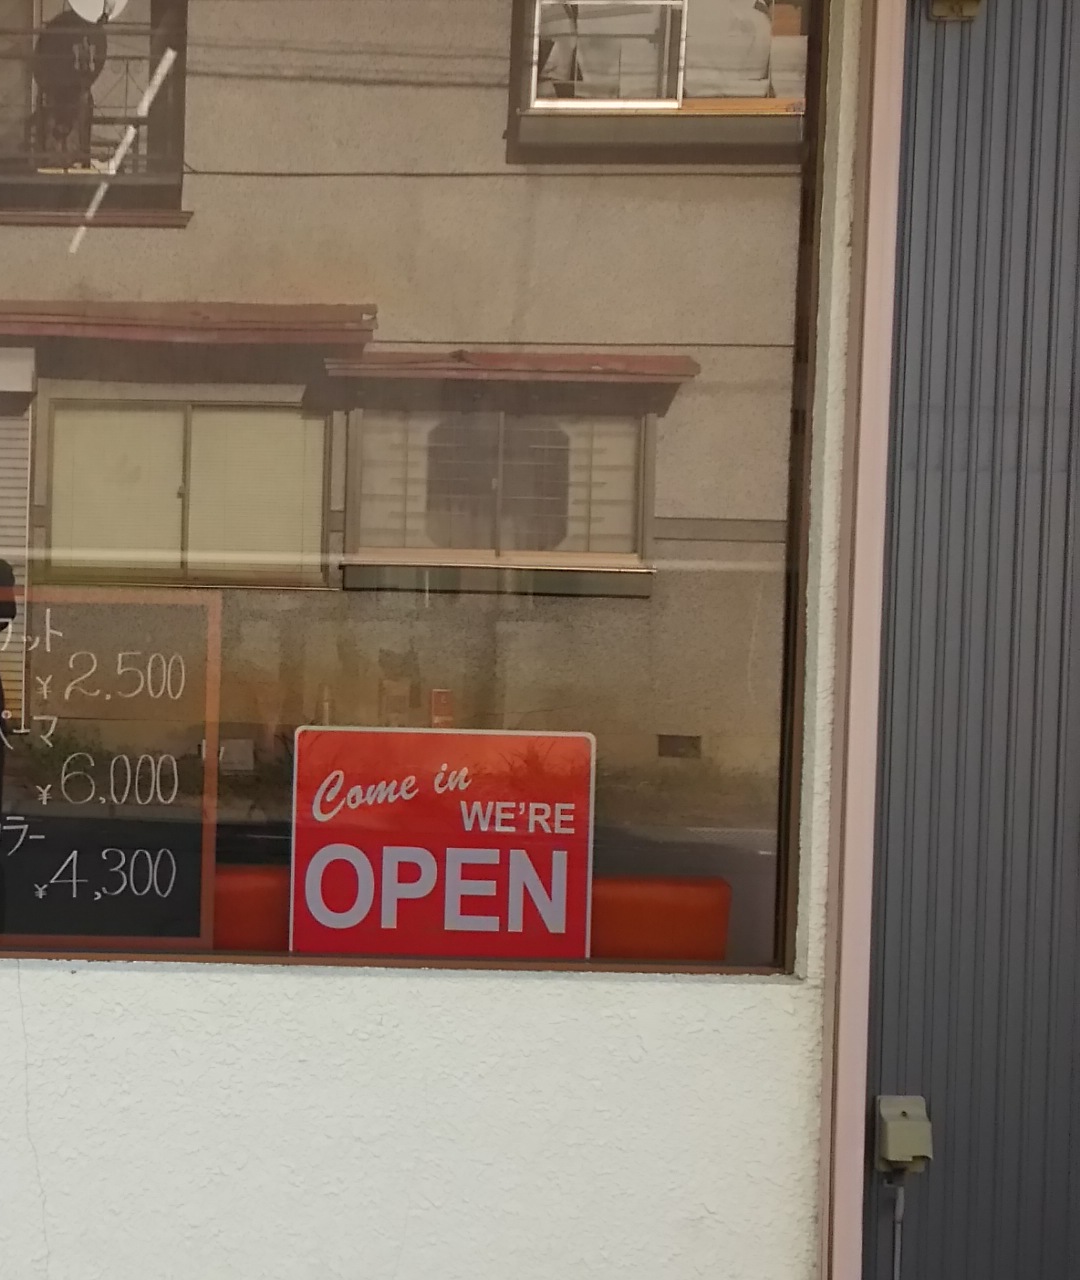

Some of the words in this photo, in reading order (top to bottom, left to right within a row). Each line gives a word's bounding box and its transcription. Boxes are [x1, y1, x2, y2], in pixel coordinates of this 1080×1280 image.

[311, 769, 420, 823] Come
[433, 762, 473, 795] in
[459, 800, 577, 835] WE'RE
[304, 842, 569, 935] OPEN
